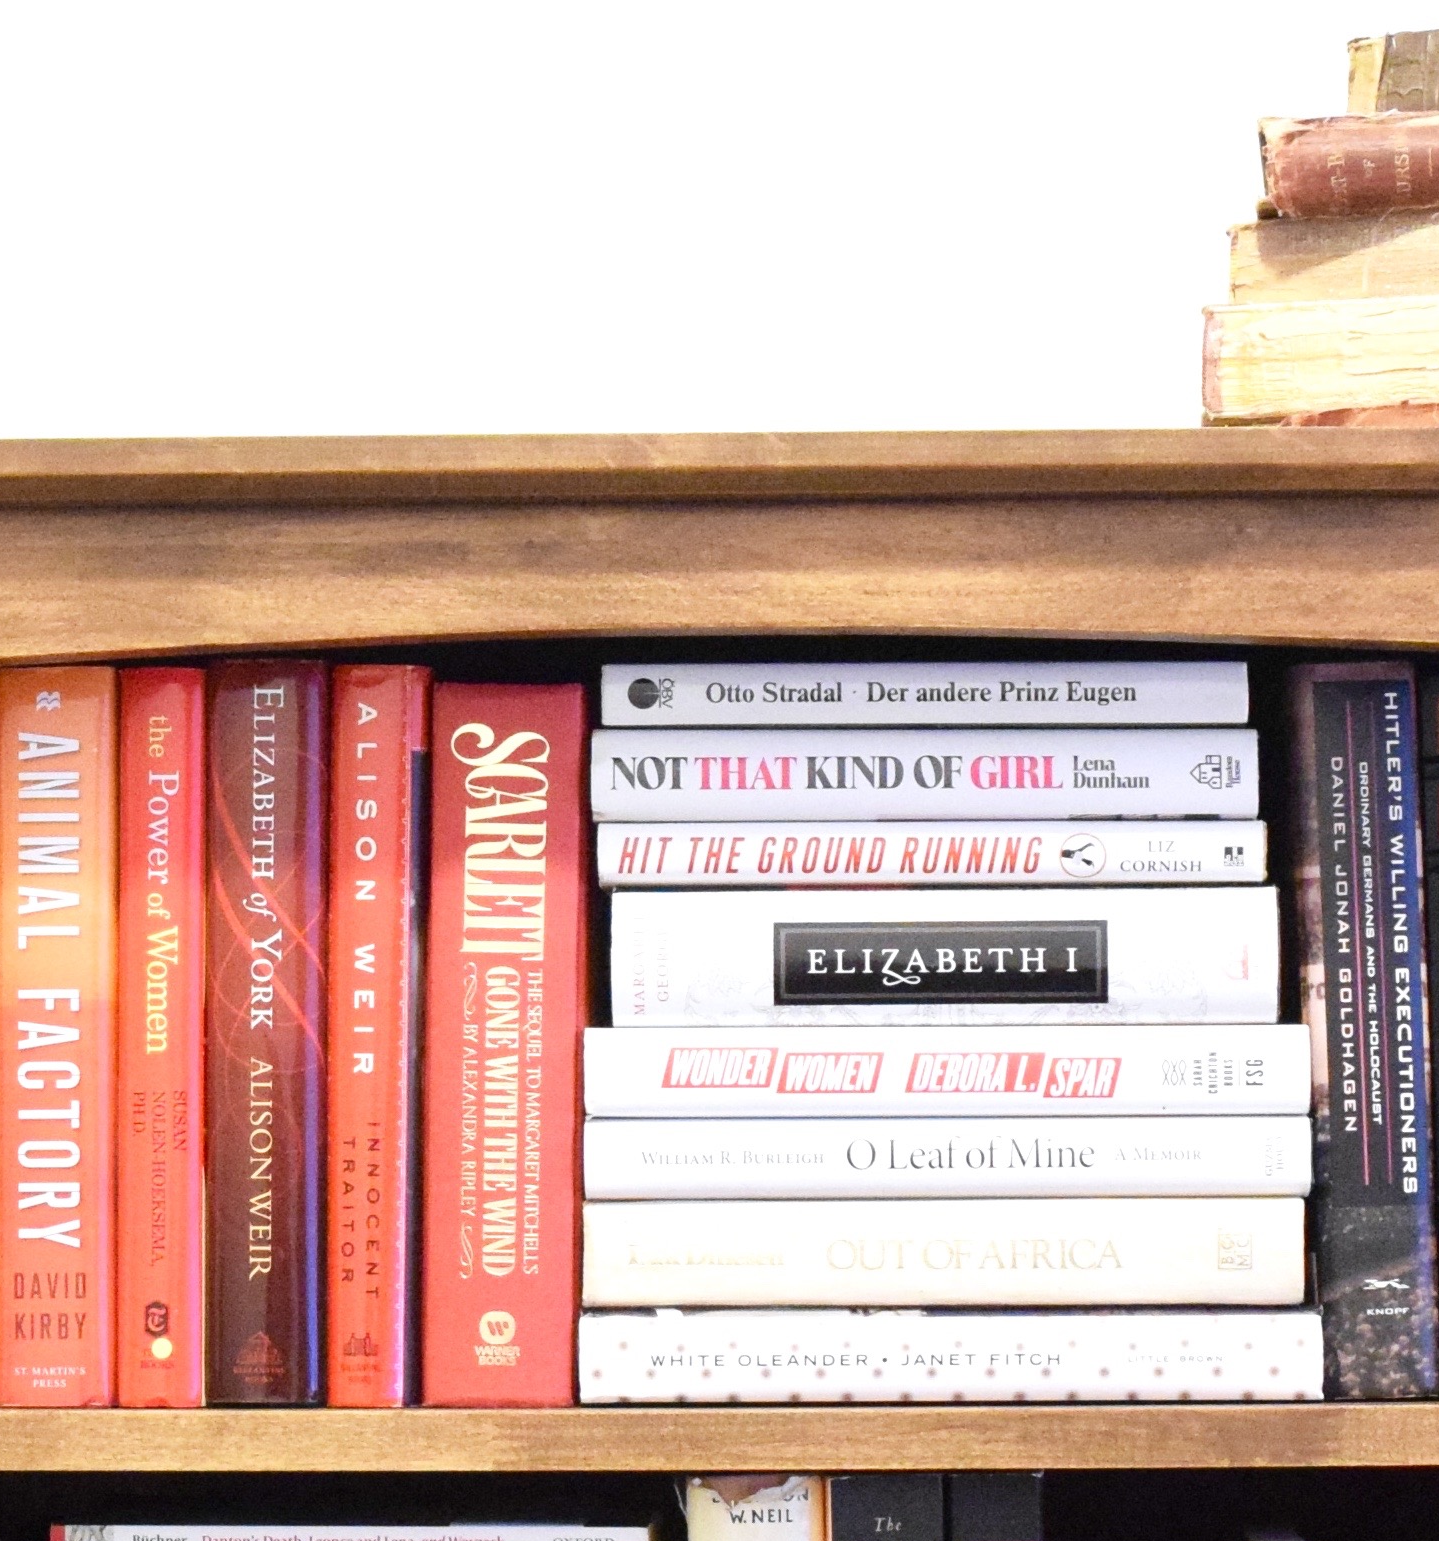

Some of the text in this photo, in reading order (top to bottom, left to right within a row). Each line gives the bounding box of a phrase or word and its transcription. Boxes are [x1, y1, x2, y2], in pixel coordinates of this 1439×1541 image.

[706, 681, 1136, 705] Otto Stradal Der andere Prinz Eugen
[611, 757, 1063, 791] NOT THAT KIND OF GIRL
[1073, 756, 1115, 773] Lena
[1073, 772, 1150, 789] Dunham
[451, 722, 551, 961] SCARLETT
[618, 837, 1042, 875] HIT THE GROUND RUNNING
[145, 716, 180, 1054] the Power of Women
[355, 702, 378, 1074] ALISON WEIR
[1383, 693, 1418, 1194] HITLER'S WILLING EXECUTIONERS
[807, 948, 1078, 985] ELIZABETH I
[17, 733, 81, 1248] ANIMAL FACTORY
[484, 965, 519, 1277] GONE WITH THE WIND
[651, 1352, 1060, 1367] WHITE OLEANDER JANET FITCH
